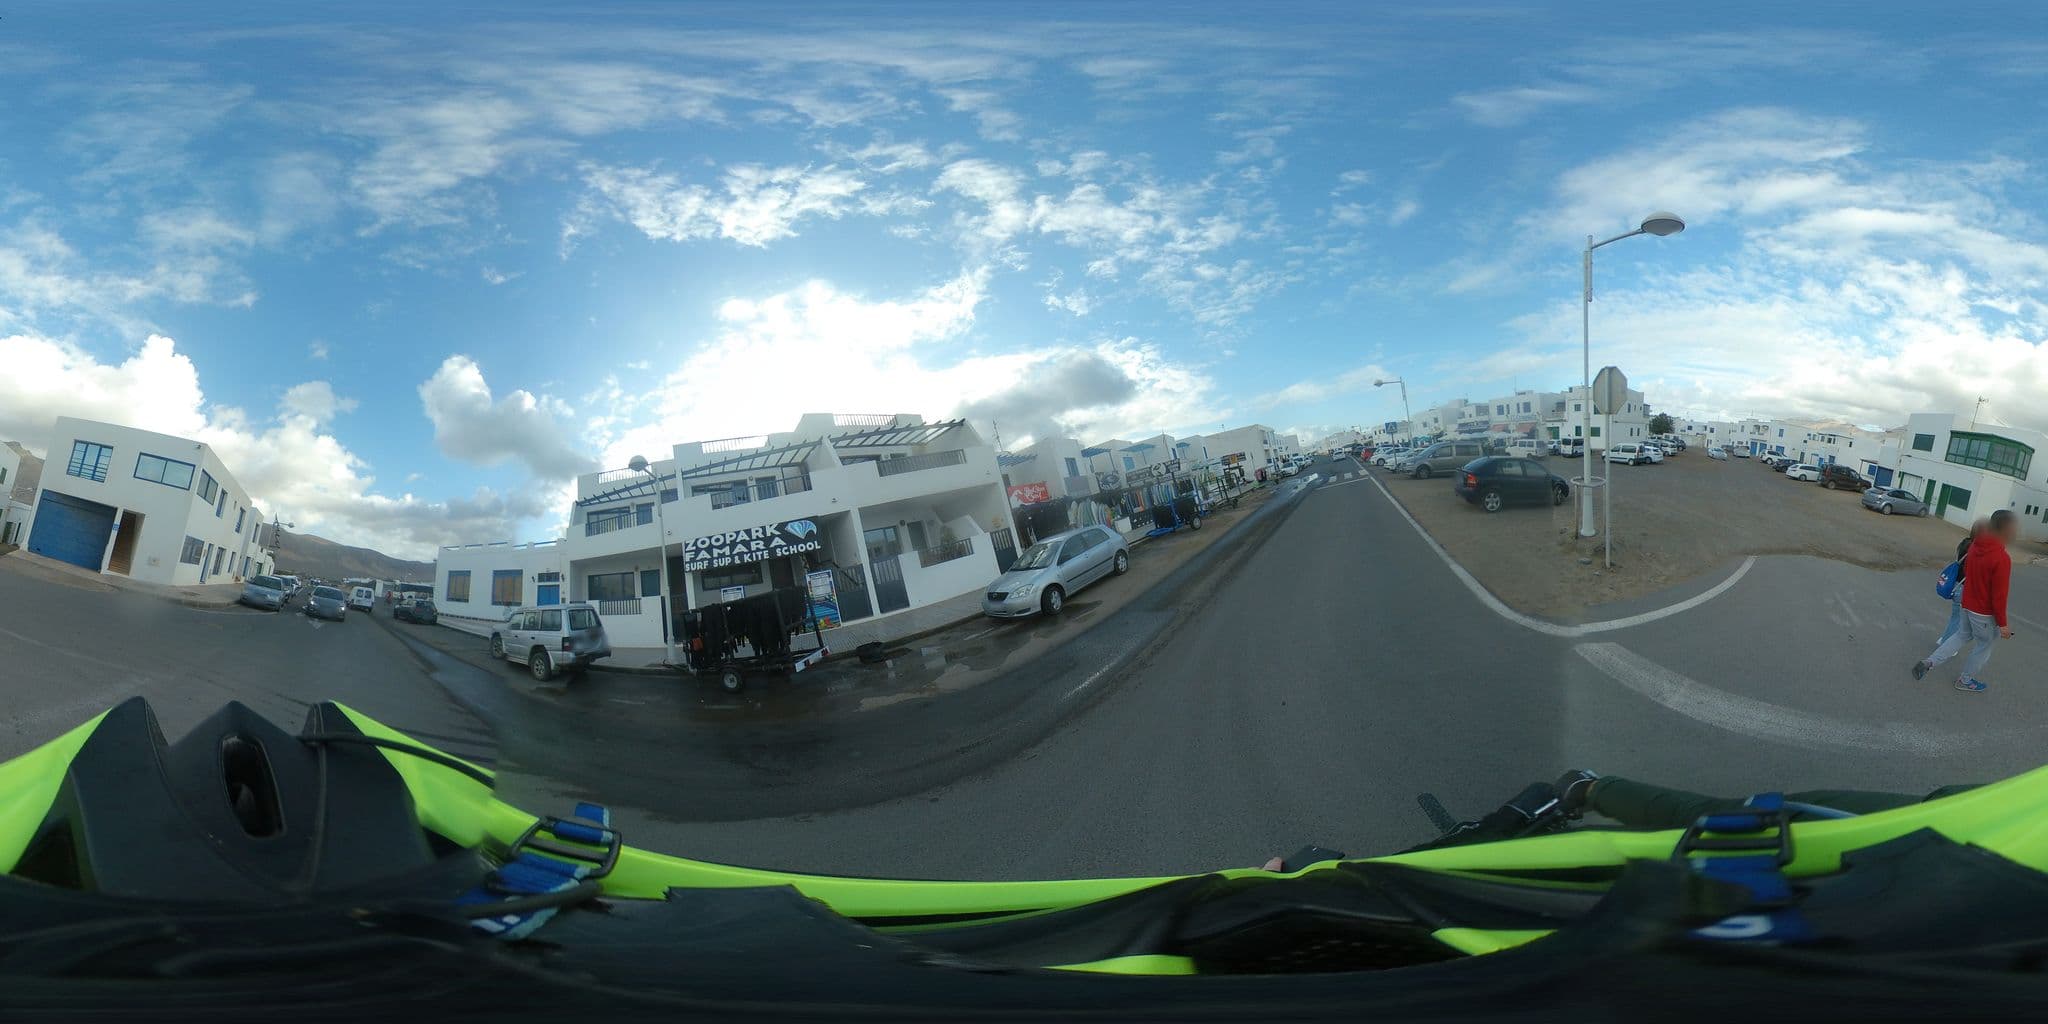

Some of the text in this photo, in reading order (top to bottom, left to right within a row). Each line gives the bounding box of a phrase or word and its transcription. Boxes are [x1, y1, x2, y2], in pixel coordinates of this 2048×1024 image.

[685, 523, 781, 551] ZOOPARK
[685, 537, 786, 562] FAMARA
[685, 540, 821, 571] SURF SUP & KITE SCHOOL
